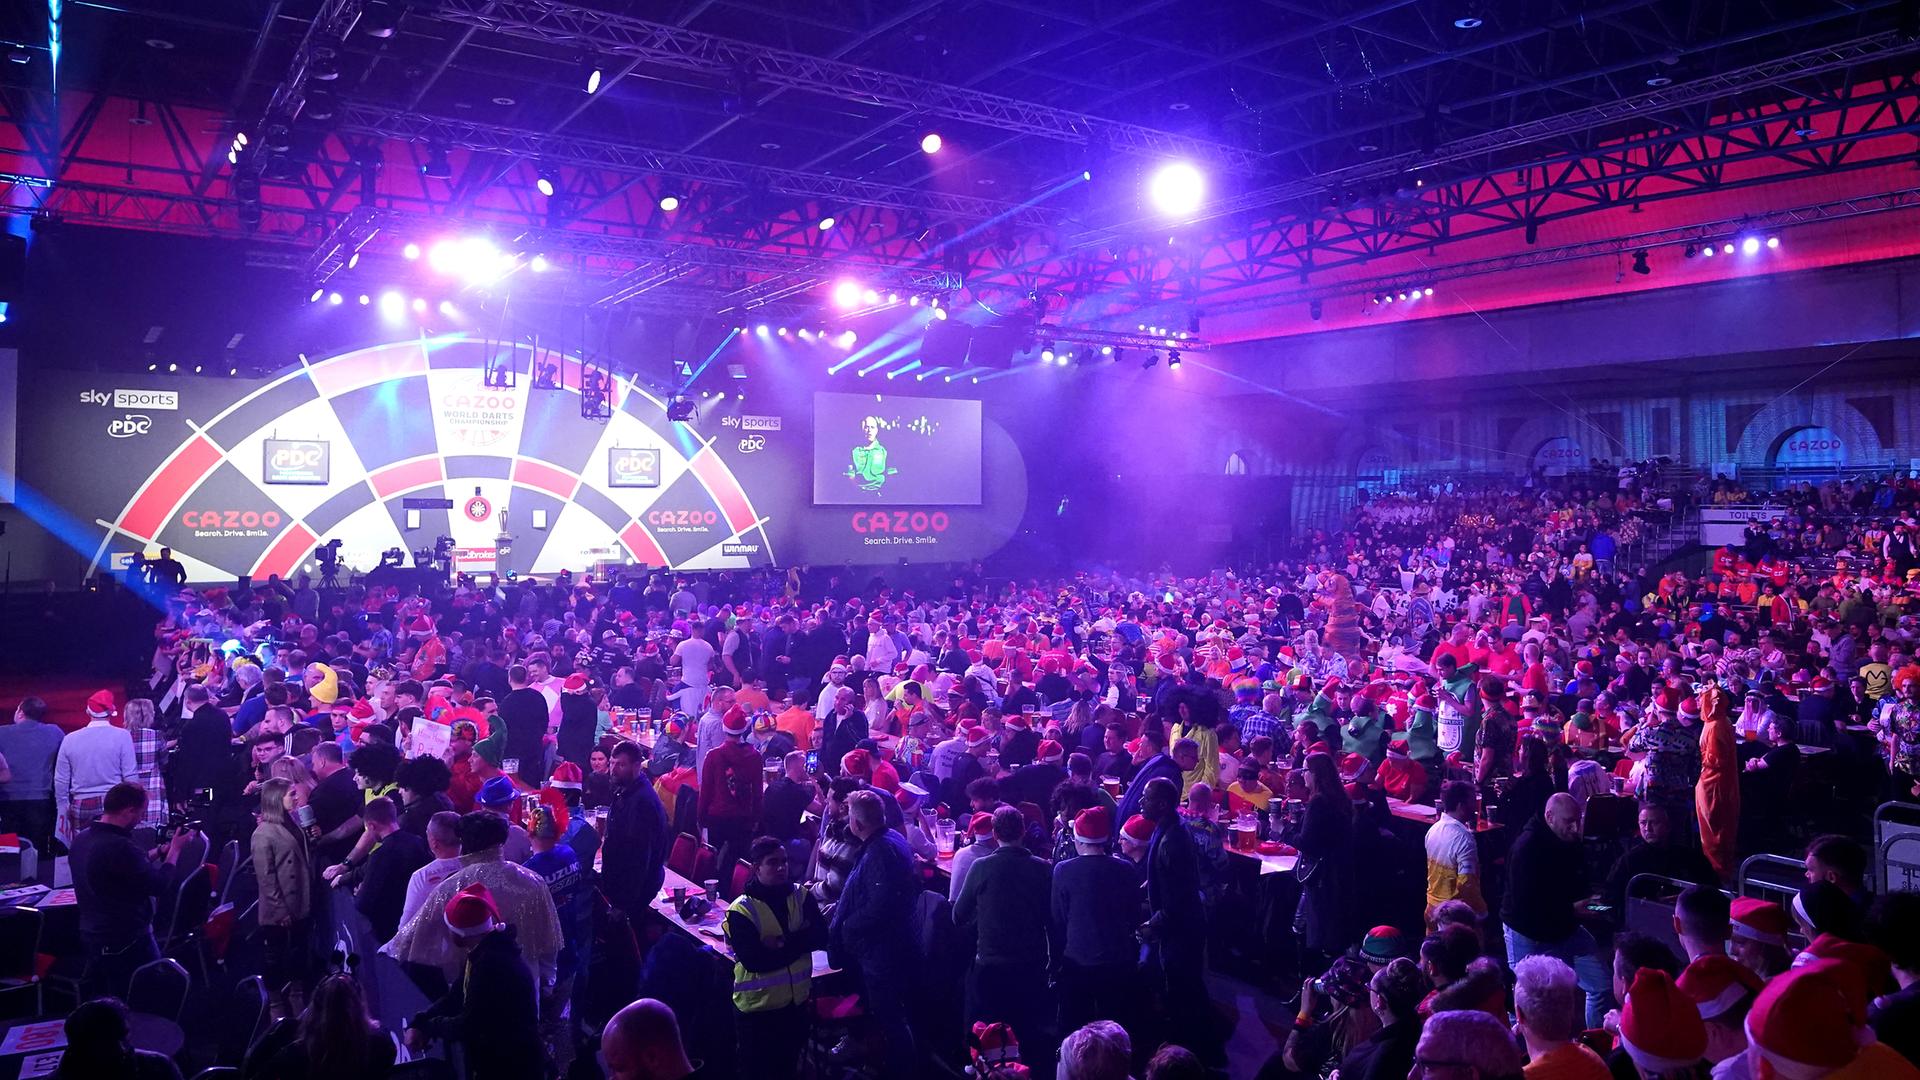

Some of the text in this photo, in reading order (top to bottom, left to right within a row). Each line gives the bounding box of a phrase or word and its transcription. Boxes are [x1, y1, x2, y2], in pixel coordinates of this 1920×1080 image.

[80, 389, 174, 406] sky sports
[443, 395, 515, 409] CAZOO
[482, 412, 514, 420] DARTS
[721, 415, 779, 429] sky sports
[111, 419, 149, 435] PDC
[1789, 440, 1841, 450] CAZOO
[275, 448, 321, 467] PDC
[182, 511, 280, 528] CAZOO
[648, 510, 717, 525] CAZOO
[852, 511, 949, 533] CAZOO
[864, 535, 938, 545] Search. Drive. Smile.
